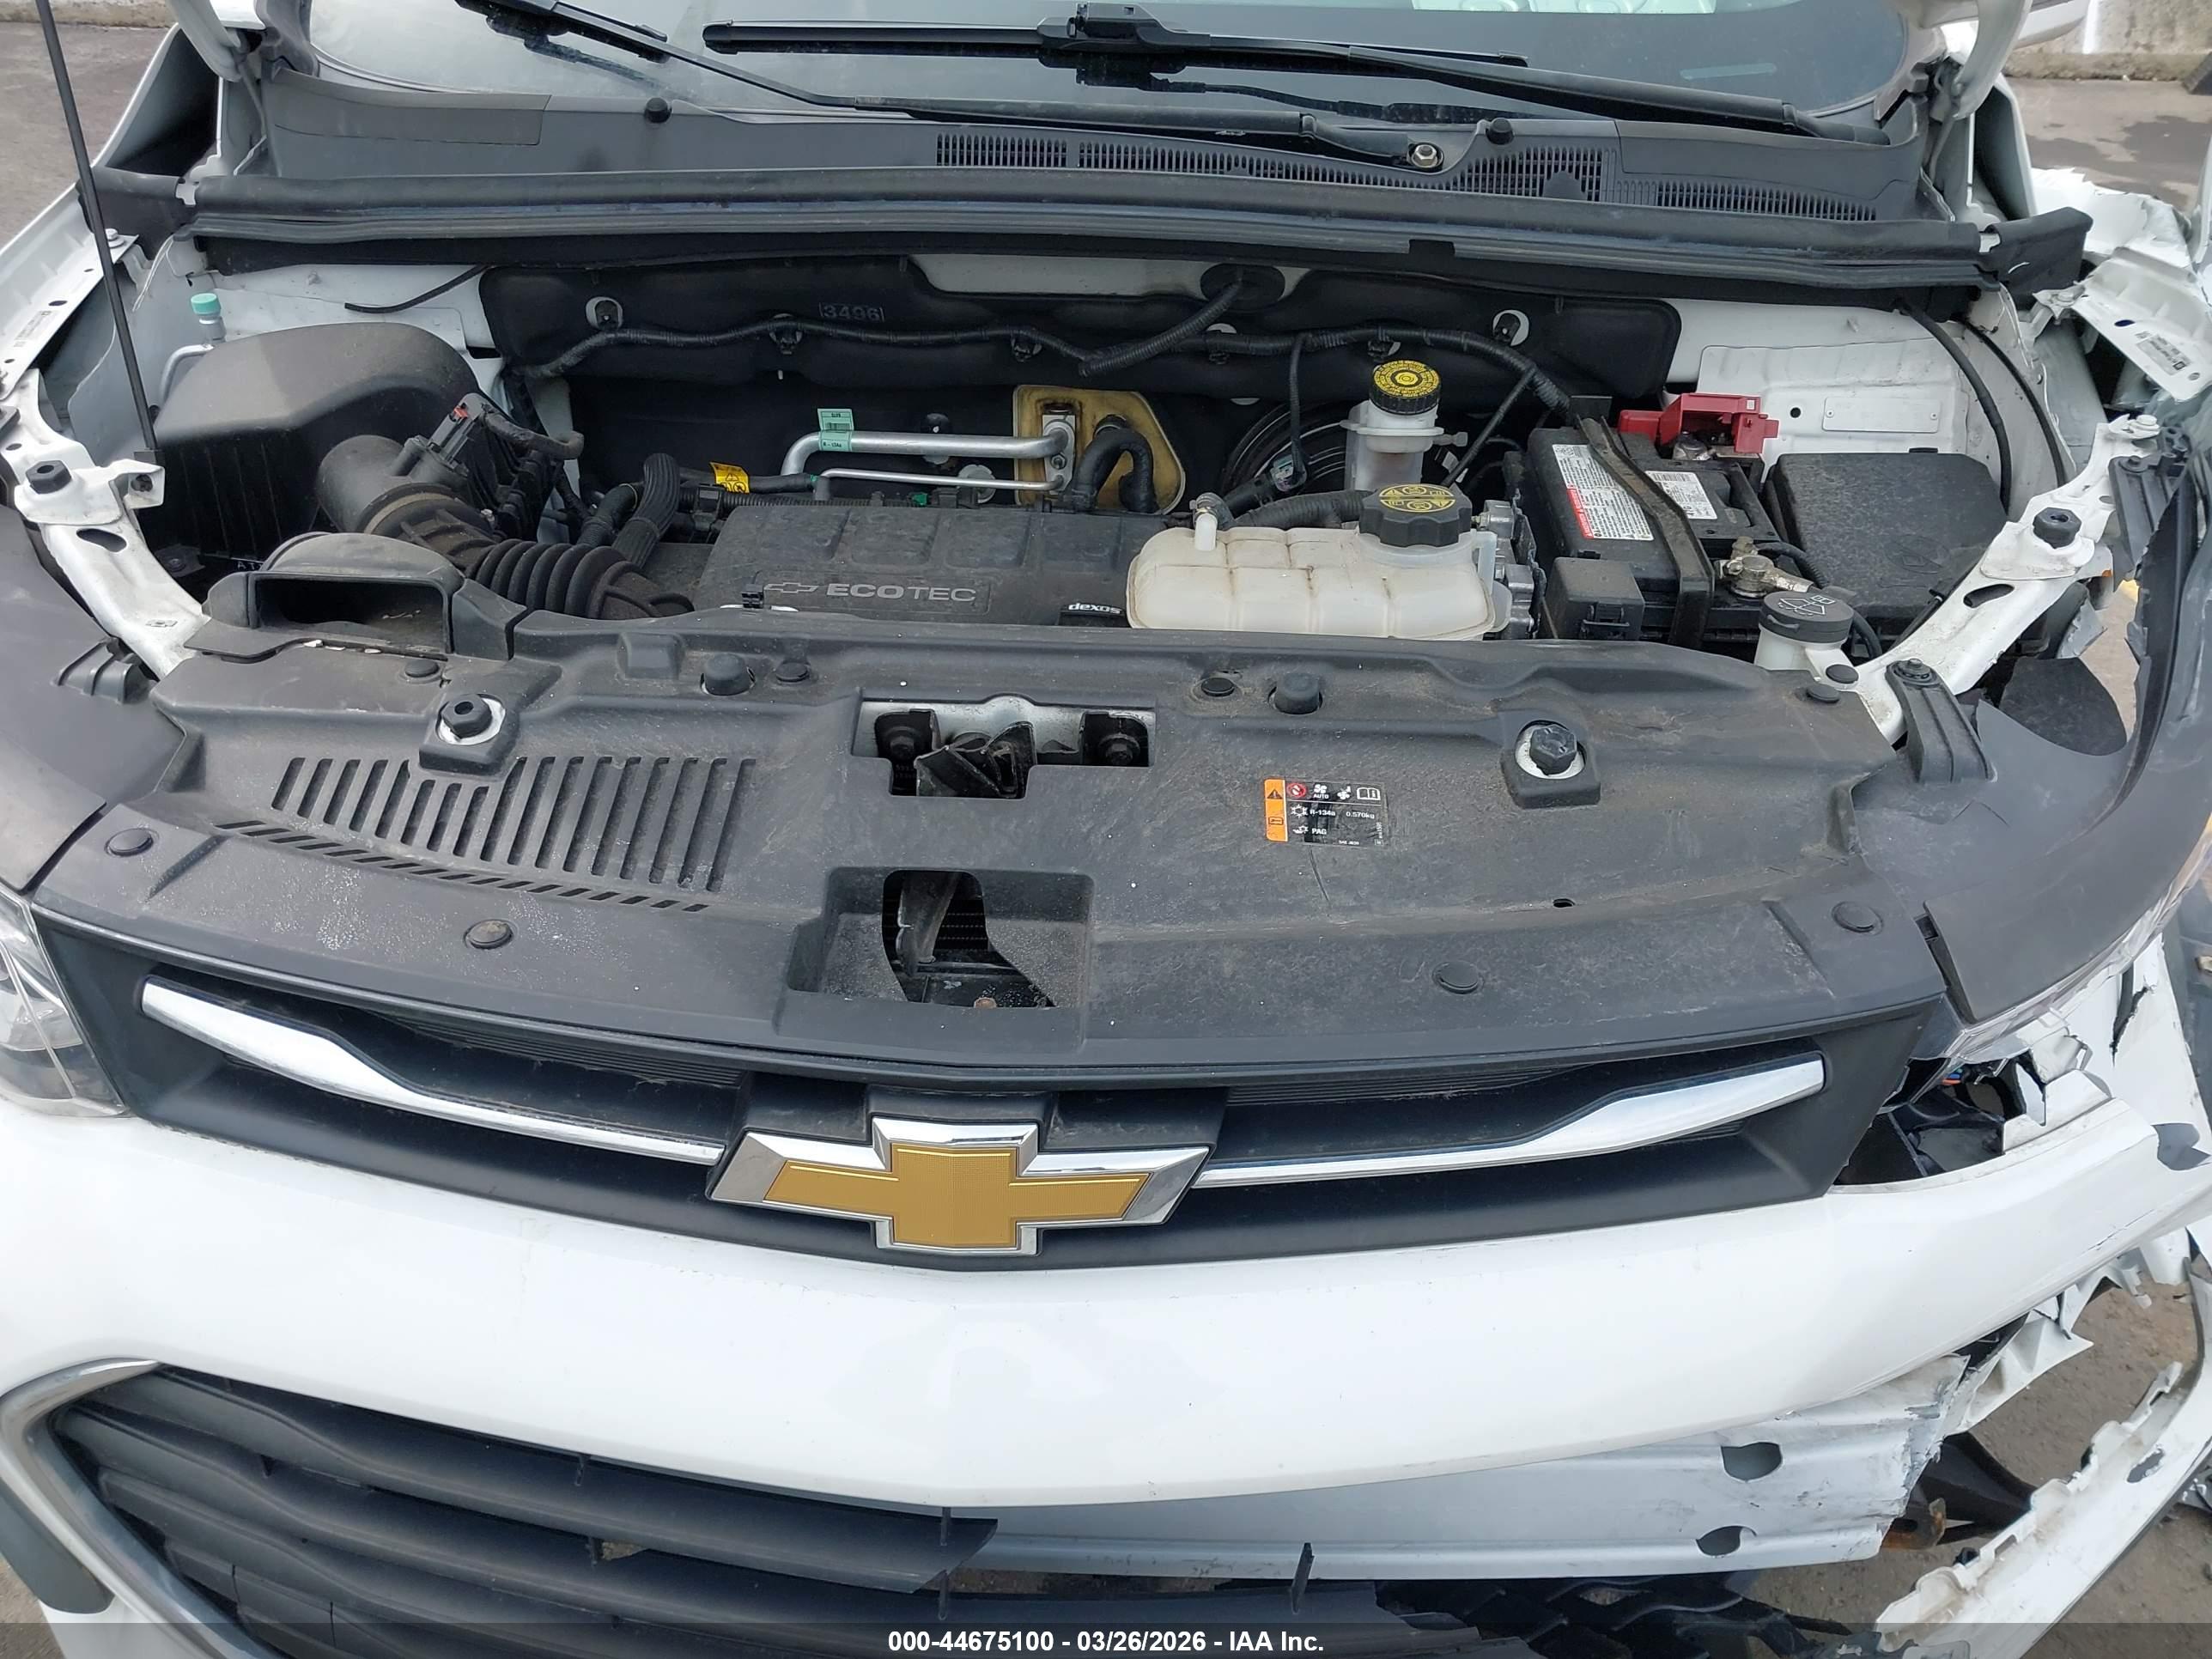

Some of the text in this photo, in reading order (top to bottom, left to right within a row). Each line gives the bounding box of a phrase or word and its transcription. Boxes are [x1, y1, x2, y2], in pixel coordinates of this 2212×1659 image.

[827, 583, 976, 602] ECOTEC
[1068, 602, 1121, 614] dexos
[1346, 811, 1375, 820] 0.570kg
